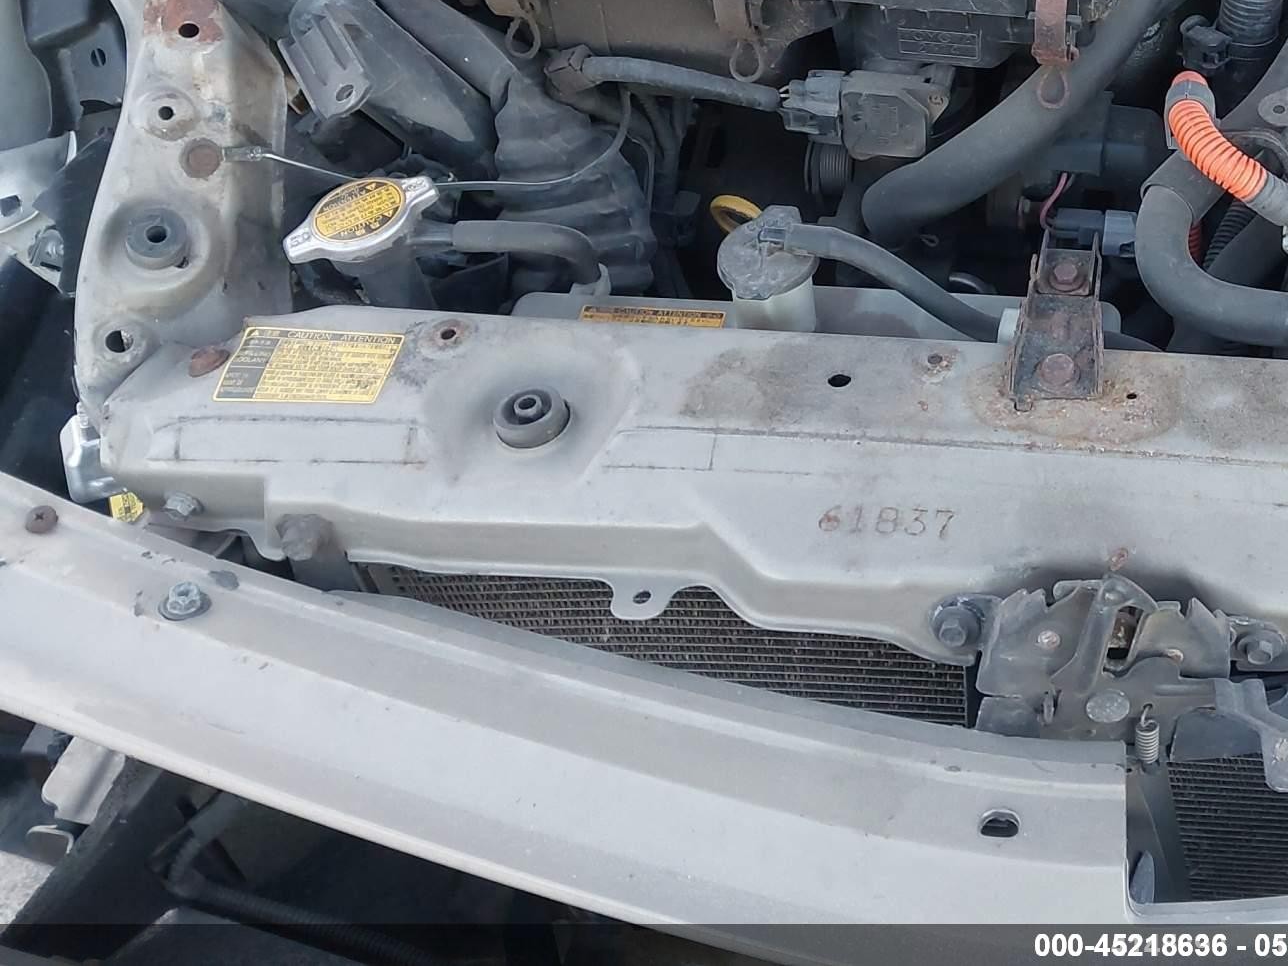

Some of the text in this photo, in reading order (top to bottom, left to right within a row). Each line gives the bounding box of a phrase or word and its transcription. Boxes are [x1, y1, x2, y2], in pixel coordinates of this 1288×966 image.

[287, 330, 332, 340] CAUTION
[340, 334, 396, 344] ATTENTION
[817, 504, 955, 541] 61837
